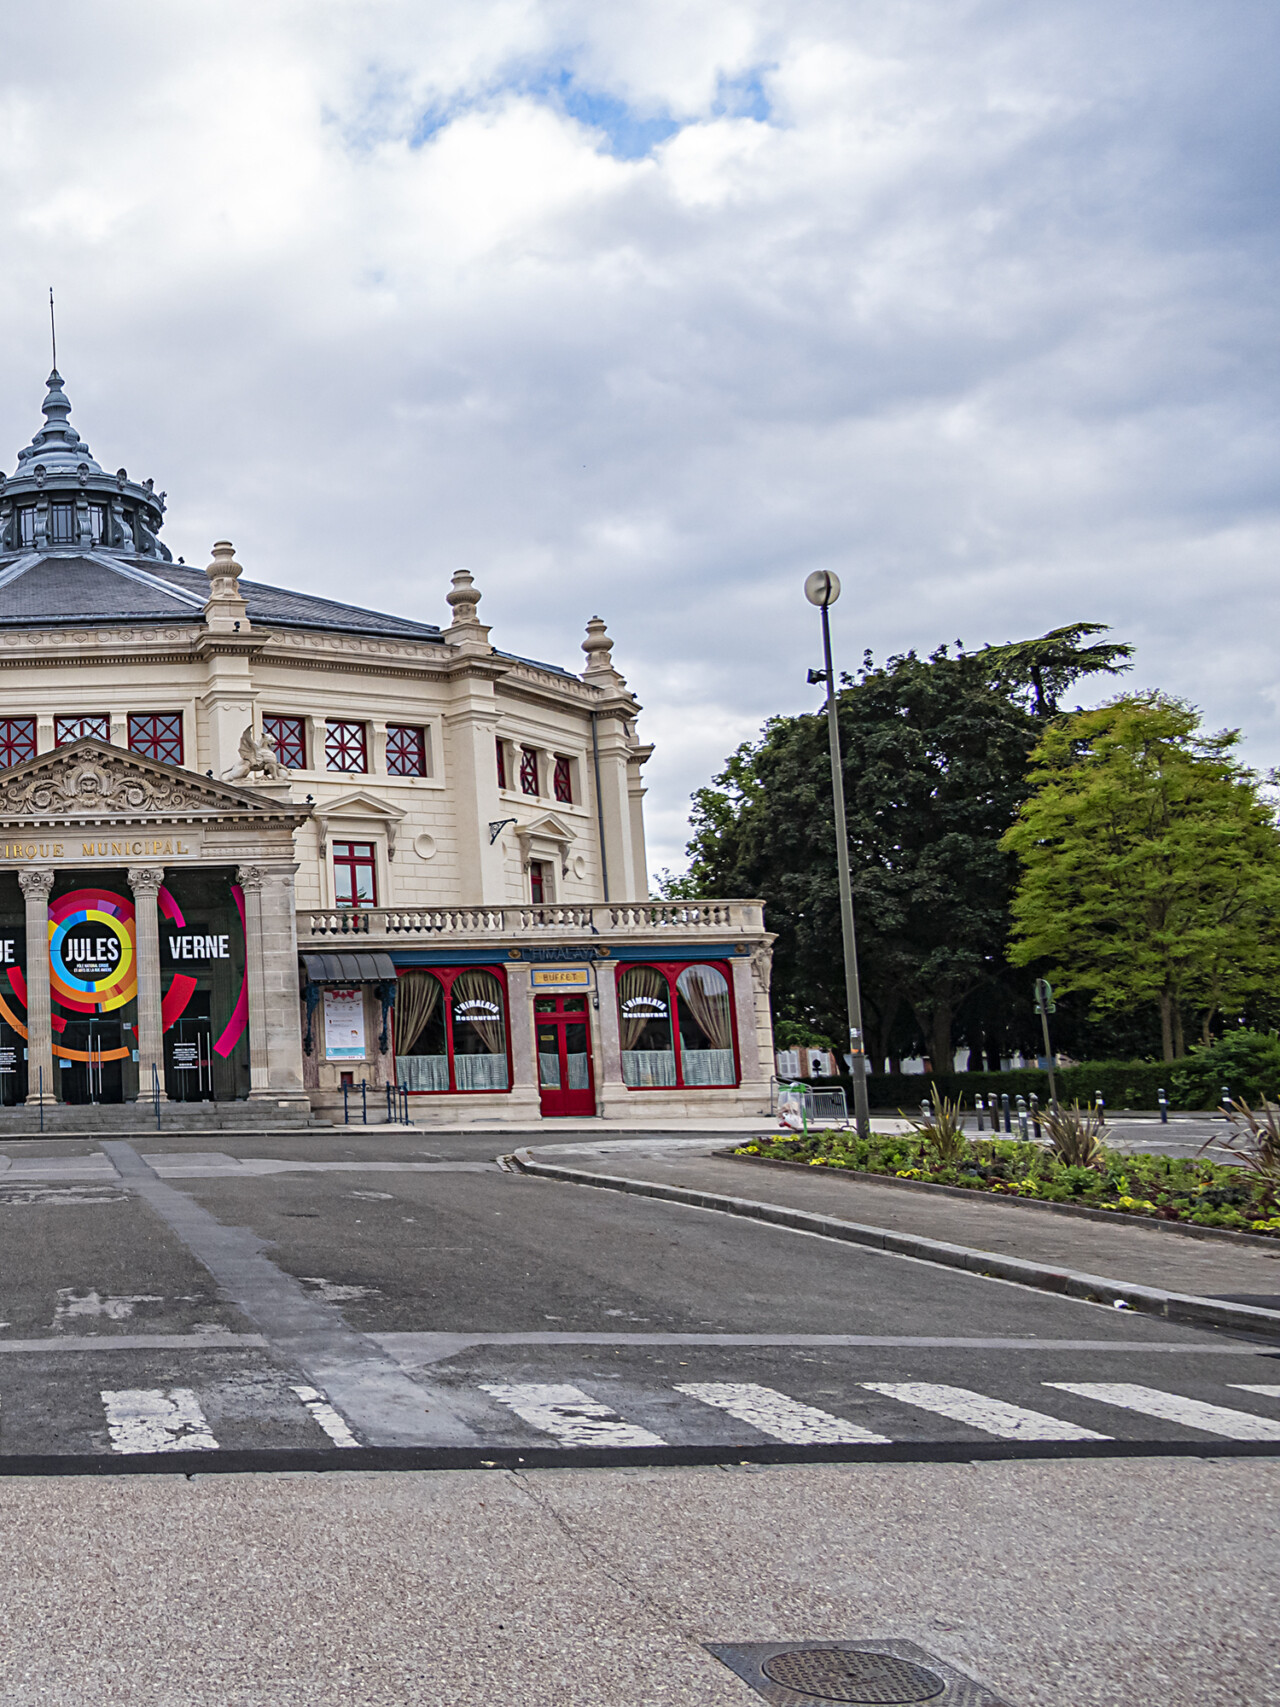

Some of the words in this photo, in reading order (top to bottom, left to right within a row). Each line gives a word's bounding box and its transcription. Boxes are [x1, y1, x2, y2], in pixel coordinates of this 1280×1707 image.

[82, 840, 189, 857] MUNICIPAL
[65, 938, 119, 961] JULES
[169, 935, 230, 959] VERNE
[543, 973, 577, 982] BUFFET
